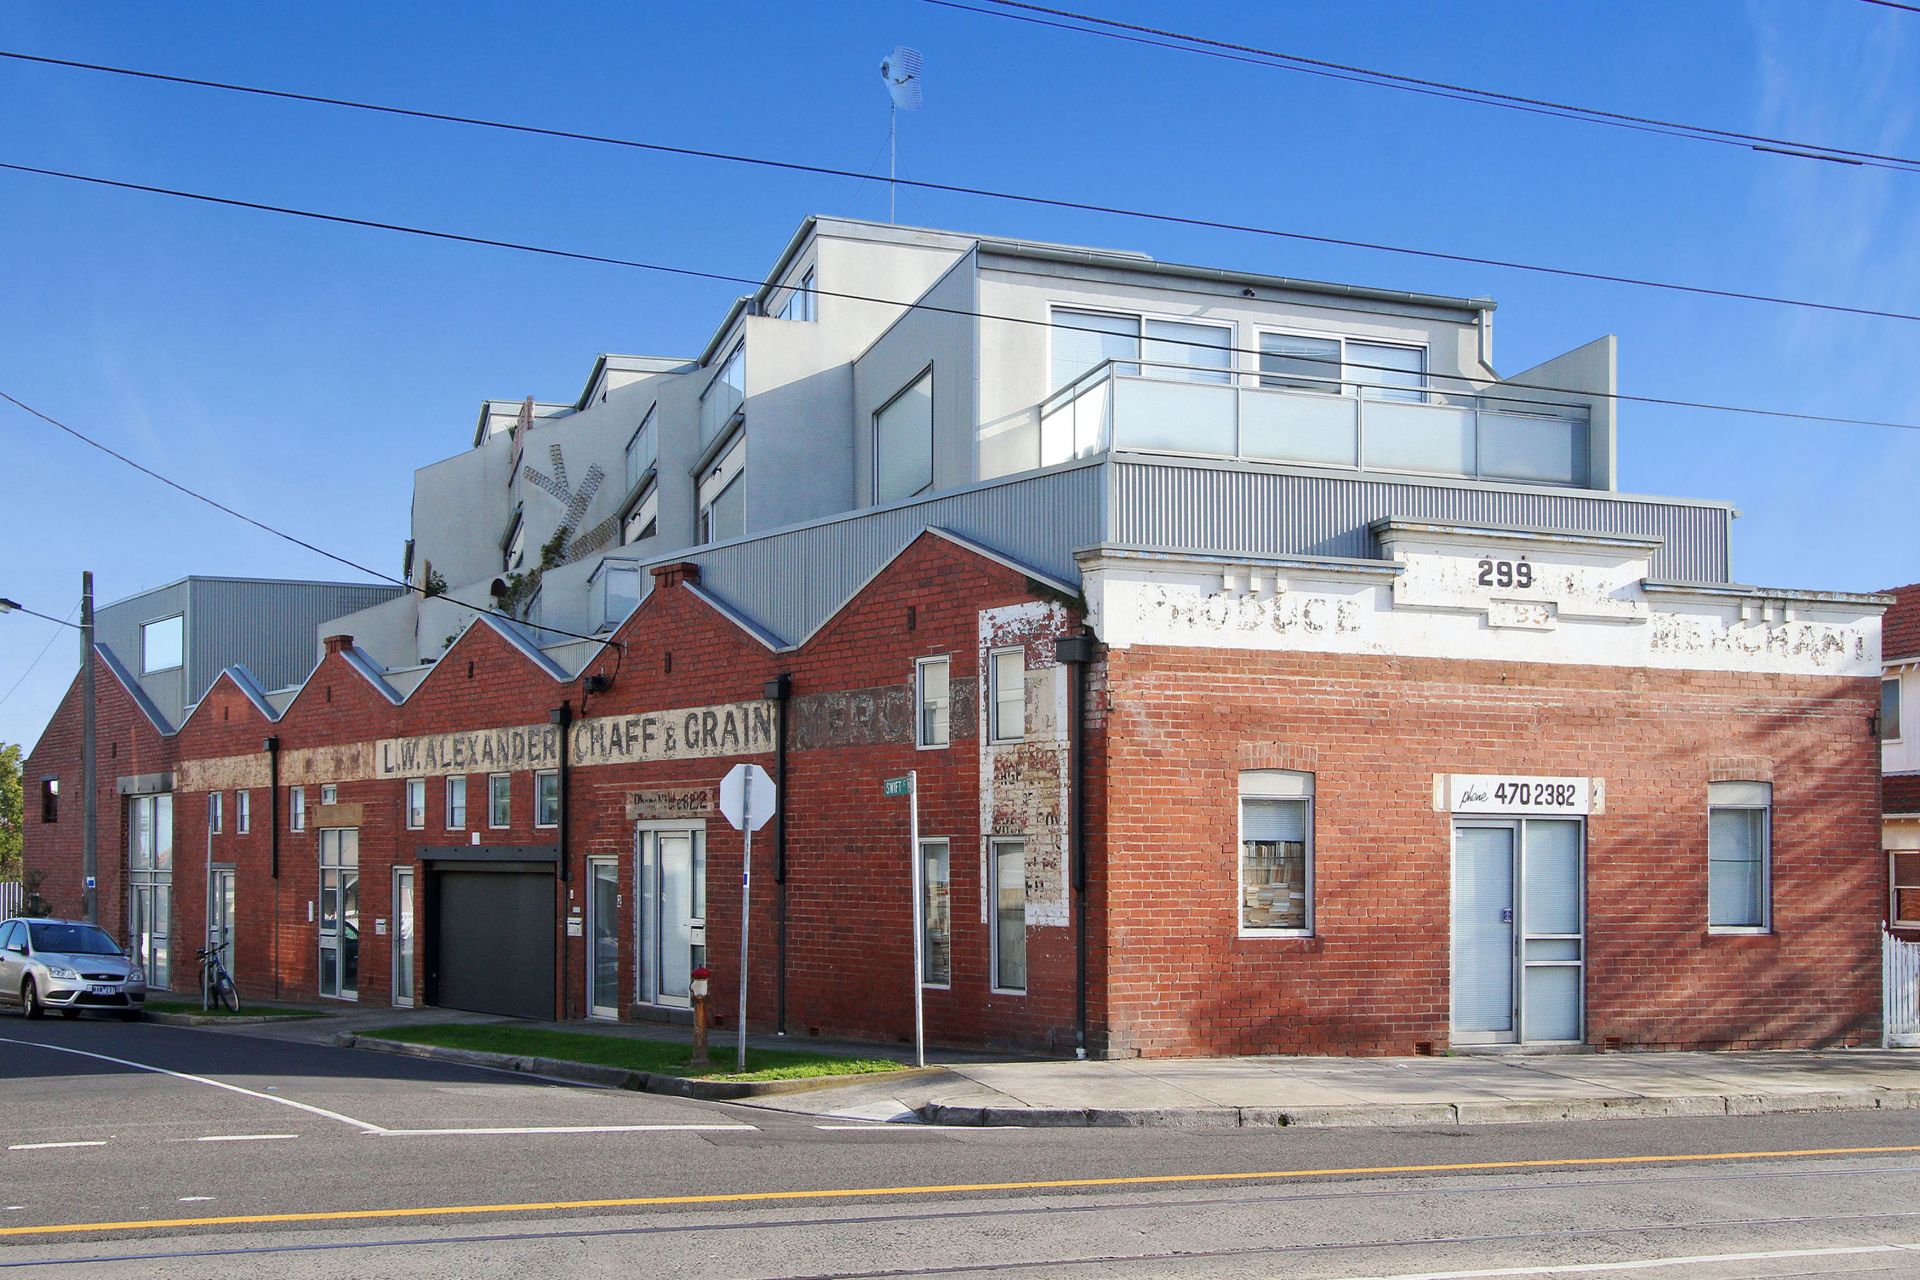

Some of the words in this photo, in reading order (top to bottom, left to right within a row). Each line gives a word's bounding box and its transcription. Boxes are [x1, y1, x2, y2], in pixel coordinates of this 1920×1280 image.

[1478, 560, 1531, 588] 299
[574, 716, 657, 763] CHAFF
[684, 703, 772, 750] GRAIN
[425, 727, 557, 770] ALEXANDER
[885, 781, 902, 795] SWIFT
[1459, 783, 1489, 809] phone
